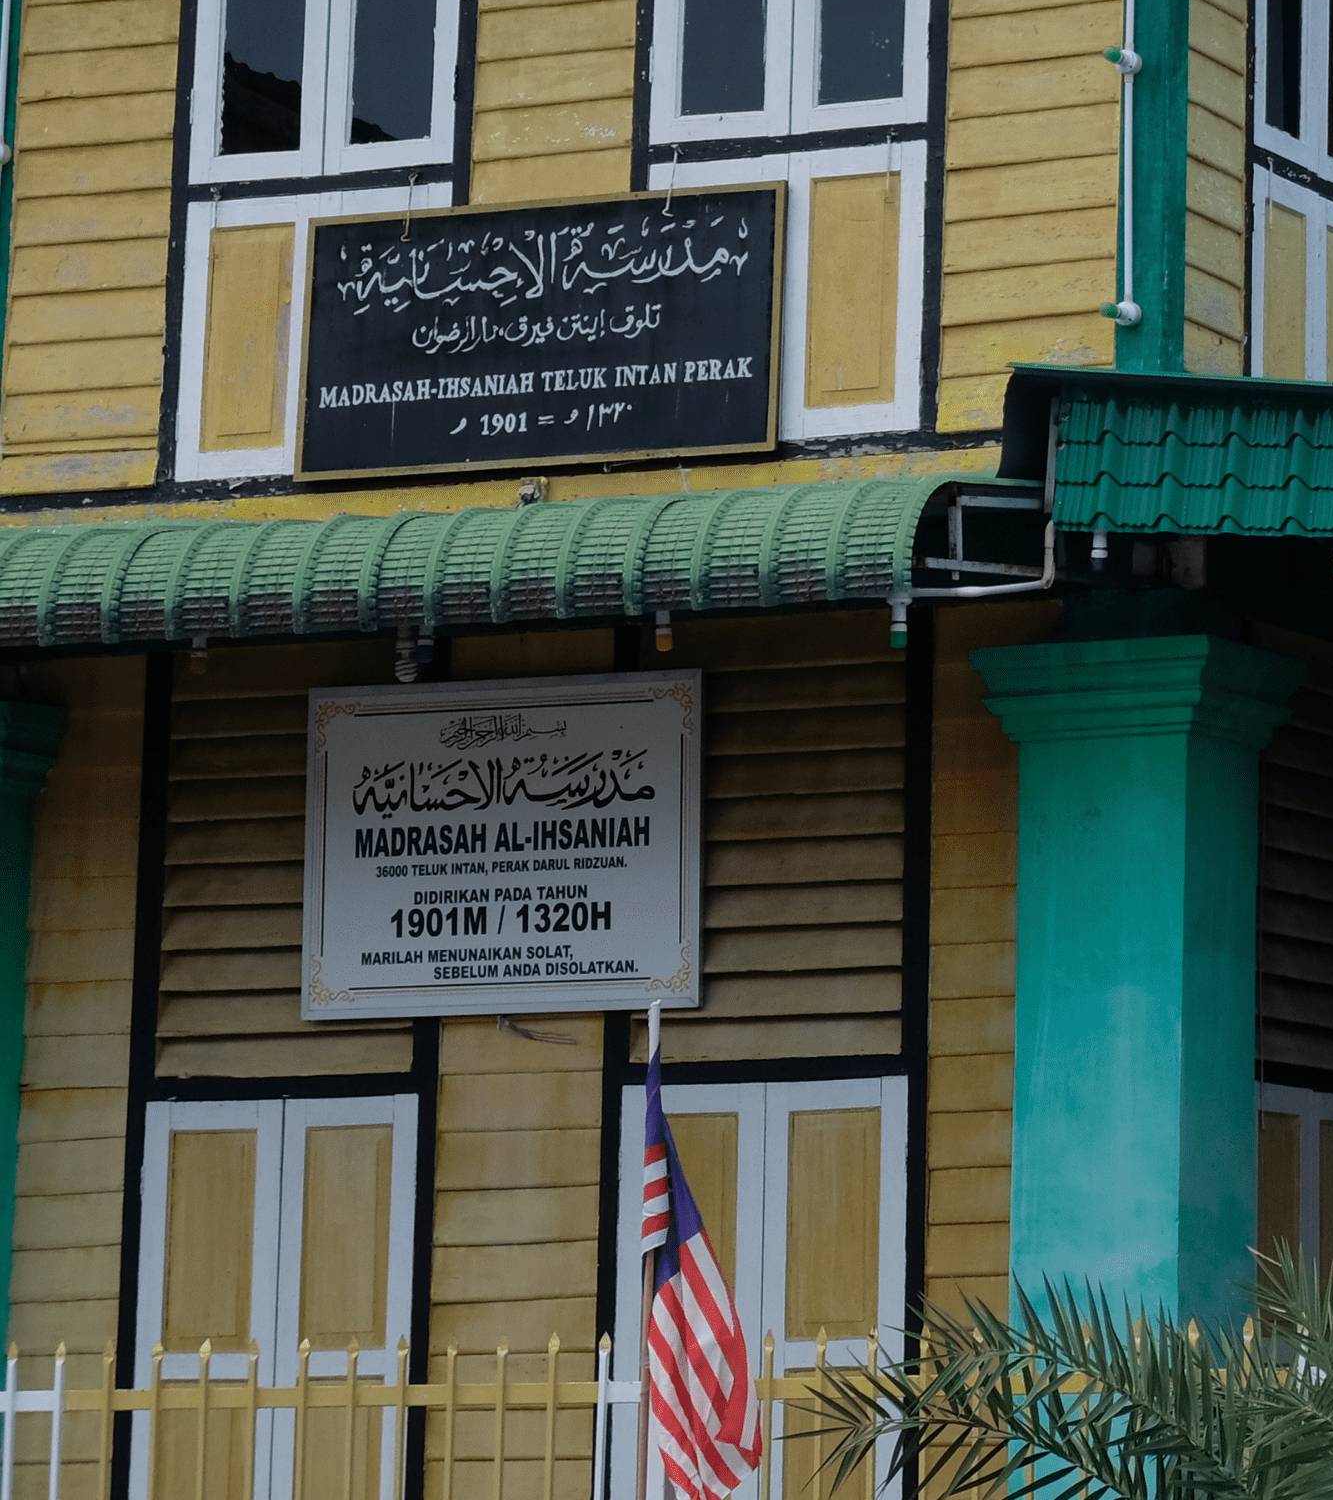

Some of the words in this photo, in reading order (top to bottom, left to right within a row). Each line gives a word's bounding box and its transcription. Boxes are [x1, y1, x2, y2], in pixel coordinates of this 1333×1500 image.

[318, 372, 535, 408] MADRASAH-IHSANIAH
[541, 367, 608, 392] TELUK
[614, 362, 678, 388] INTAN
[683, 357, 753, 383] PERAK
[479, 411, 528, 436] 1901
[355, 823, 487, 858] MADRASAH
[494, 816, 651, 852] AL-IHSANIAH
[375, 865, 409, 878] 36000
[411, 863, 448, 876] TELUK
[451, 861, 489, 876] INTAN,
[491, 859, 530, 873] PERAK
[532, 857, 570, 871] DARUL
[573, 856, 628, 870] RIDZUAN.
[413, 888, 490, 905] DIDIRIKAN
[494, 886, 533, 902] PADA
[536, 884, 588, 900] TAHUN
[390, 906, 487, 938] 1901M
[497, 904, 506, 935] /
[515, 901, 612, 933] 1320H
[361, 951, 423, 966] MARILAH
[427, 946, 522, 963] MENUNAIKAN
[526, 945, 574, 961] SOLAT,
[433, 964, 499, 980] SEBELUM
[502, 962, 542, 977] ANDA
[545, 959, 639, 976] DISOLATKAN.
